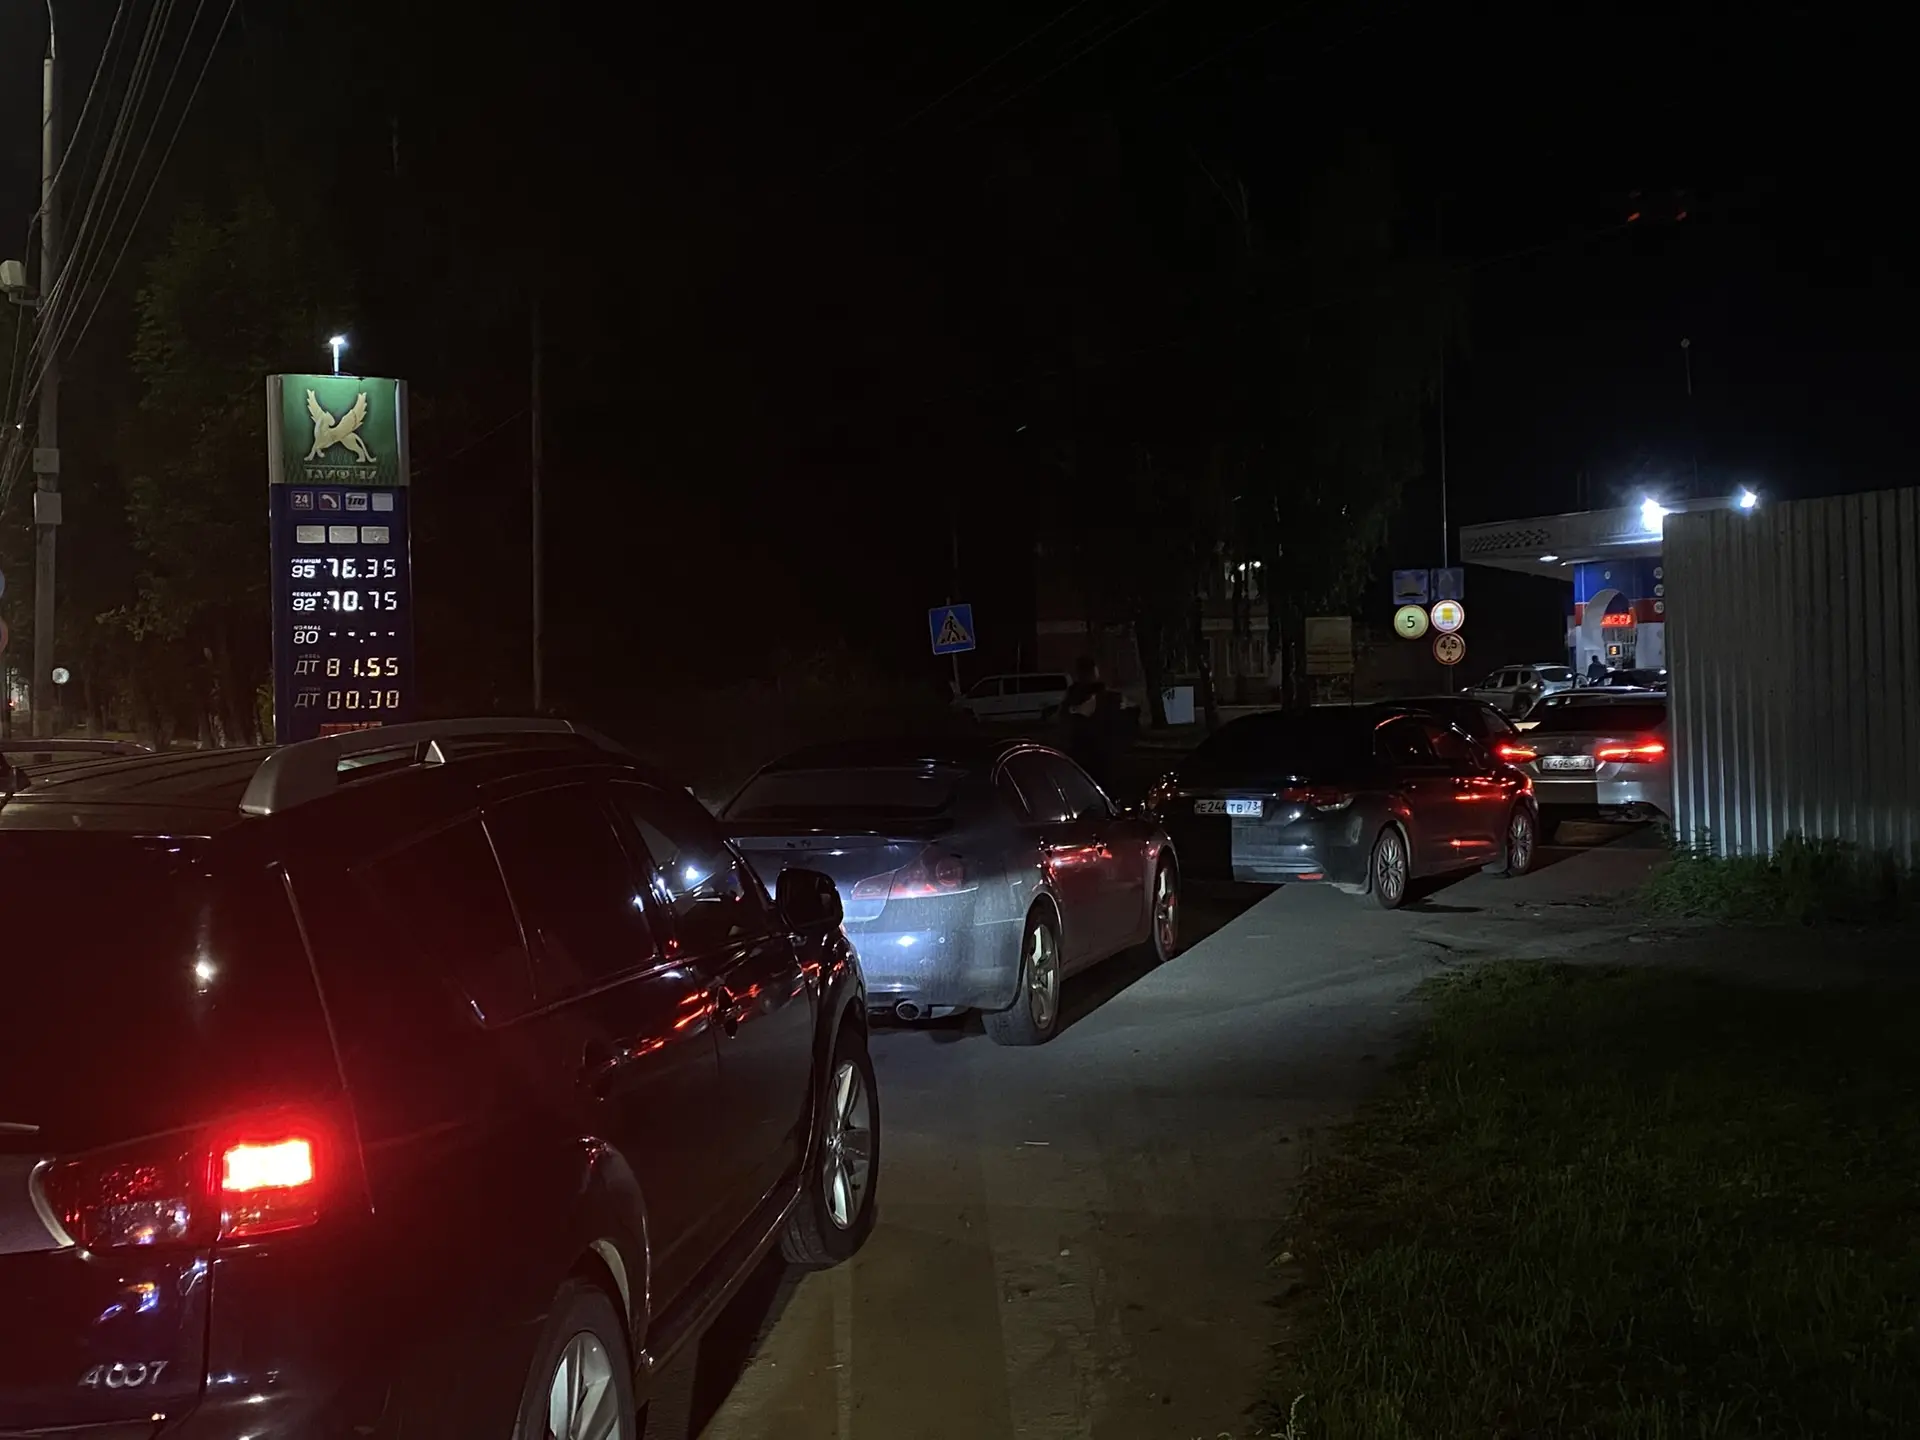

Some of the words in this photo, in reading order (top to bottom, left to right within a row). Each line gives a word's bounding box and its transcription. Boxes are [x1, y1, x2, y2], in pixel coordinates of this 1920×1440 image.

[294, 494, 309, 504] 24
[290, 564, 316, 578] 95
[291, 597, 317, 611] 92
[326, 590, 398, 612] 70.75
[1406, 615, 1416, 629] 5
[293, 630, 319, 644] 80
[293, 659, 321, 676] ДТ
[326, 657, 399, 677] 81.55
[294, 692, 321, 708] ДТ
[77, 1359, 170, 1390] 4007
